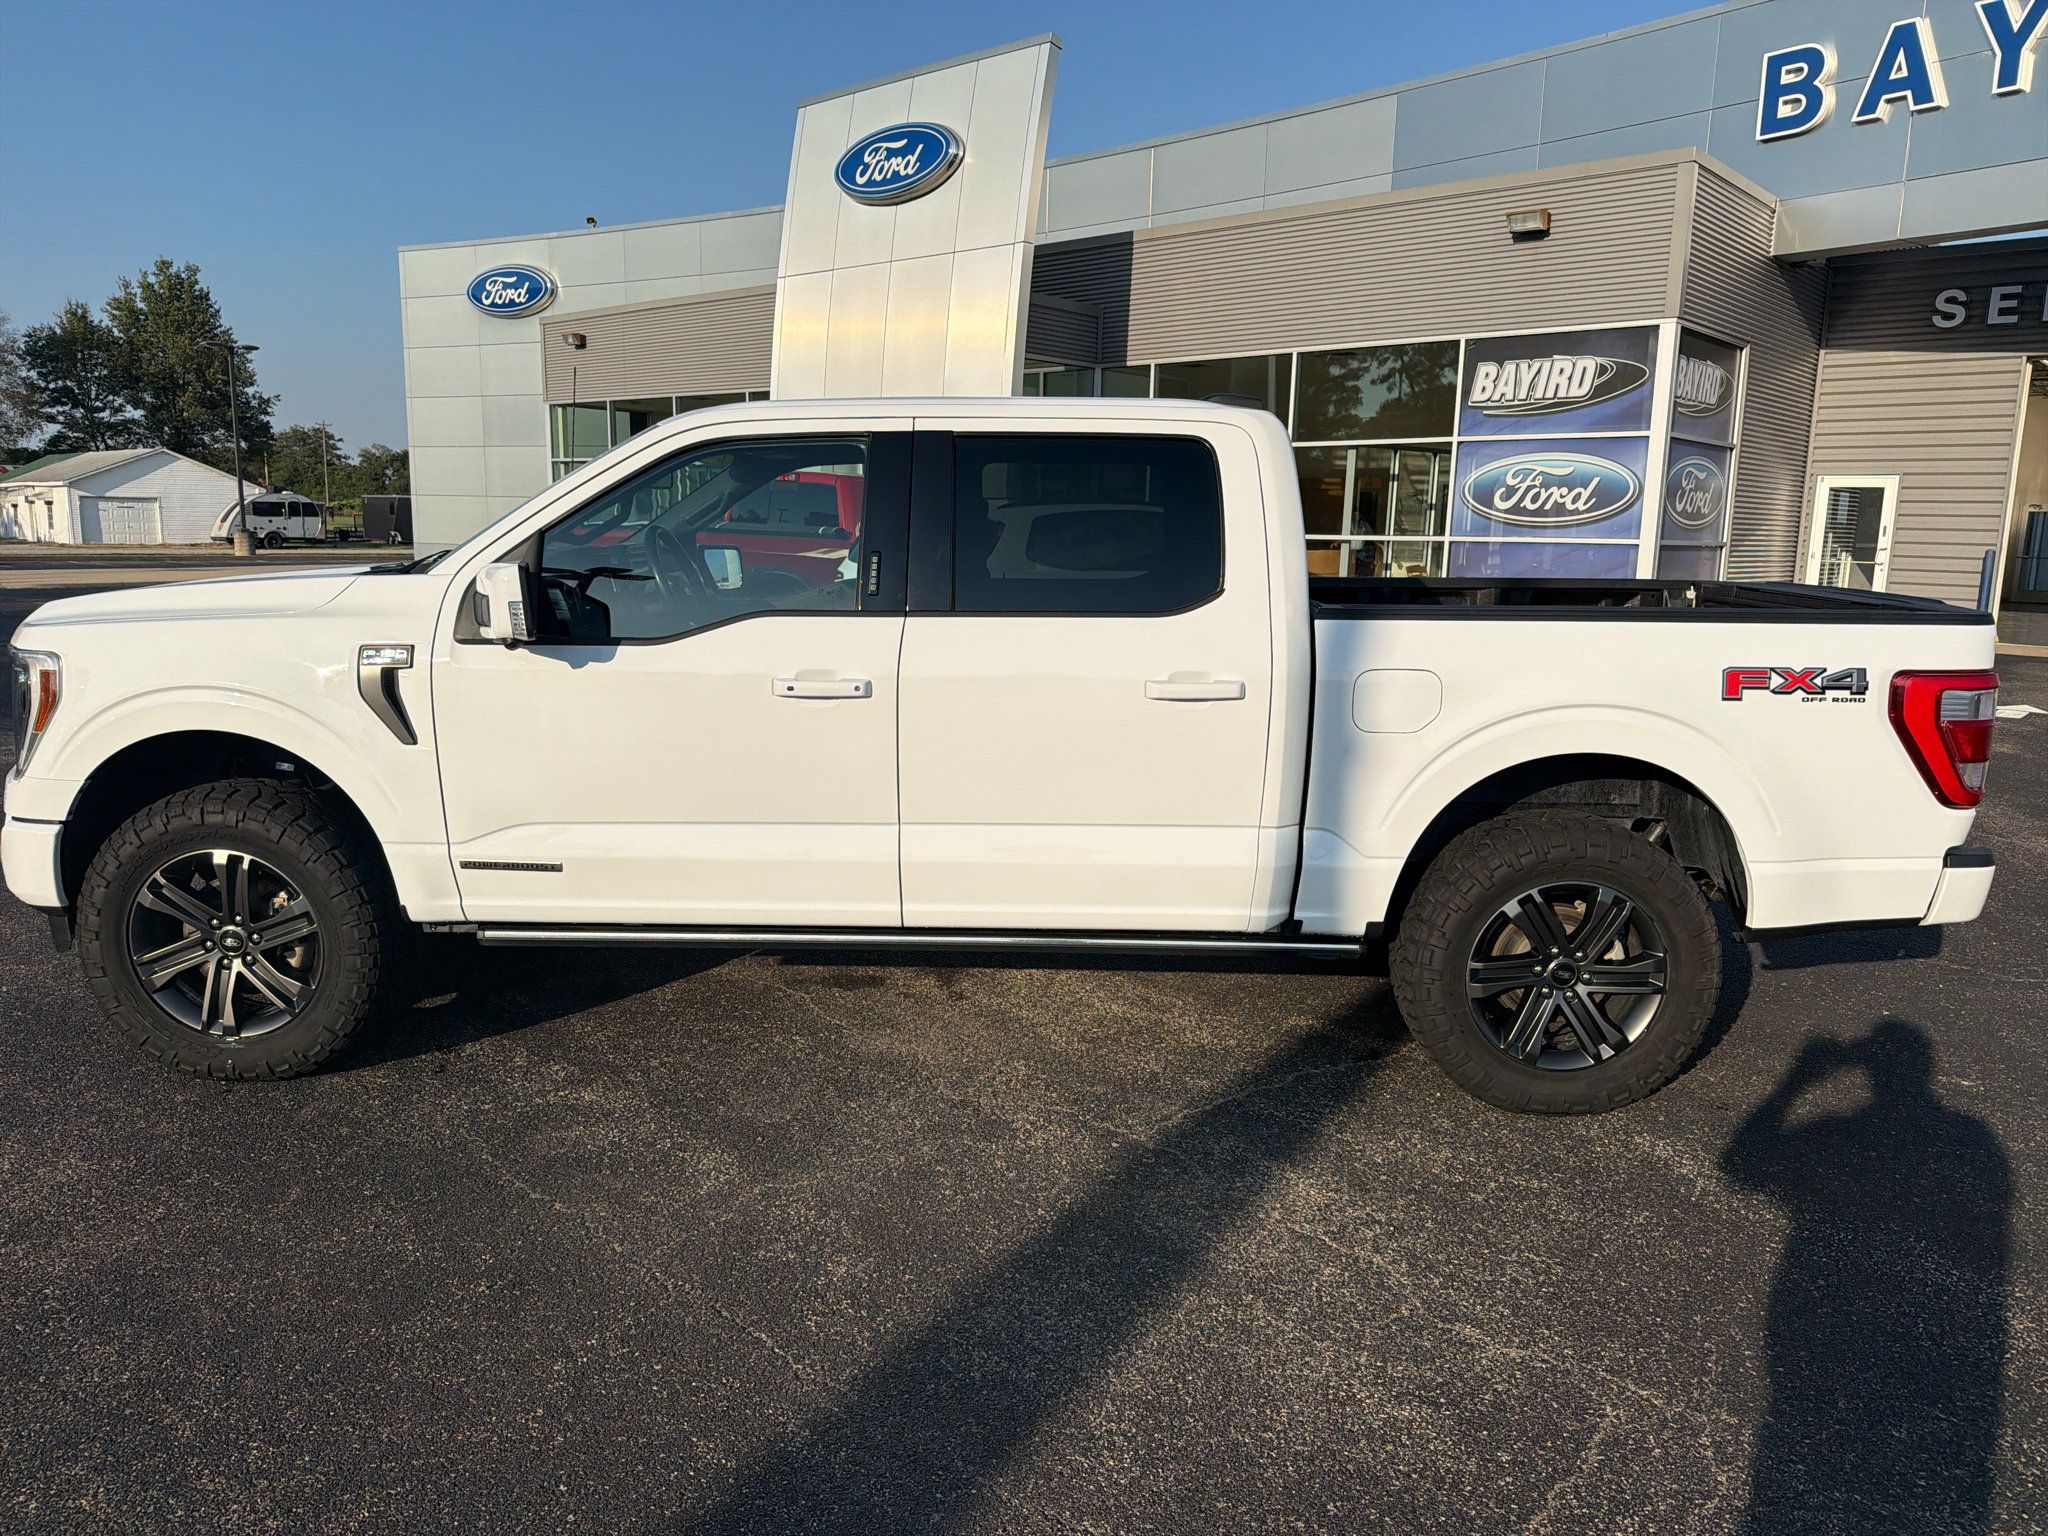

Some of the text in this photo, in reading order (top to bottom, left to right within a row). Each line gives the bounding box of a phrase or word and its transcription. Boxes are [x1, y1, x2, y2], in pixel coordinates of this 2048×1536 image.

[1755, 0, 2048, 143] BAY
[855, 138, 924, 185] Ford
[481, 276, 530, 305] Ford
[1931, 284, 2048, 329] SE
[1470, 356, 1600, 405] BAYIRD
[1676, 356, 1720, 406] BAYIRD
[1493, 463, 1601, 512] Ford
[1675, 467, 1715, 515] Ford
[1721, 666, 1869, 702] FX4
[463, 861, 556, 870] POWERBOOST
